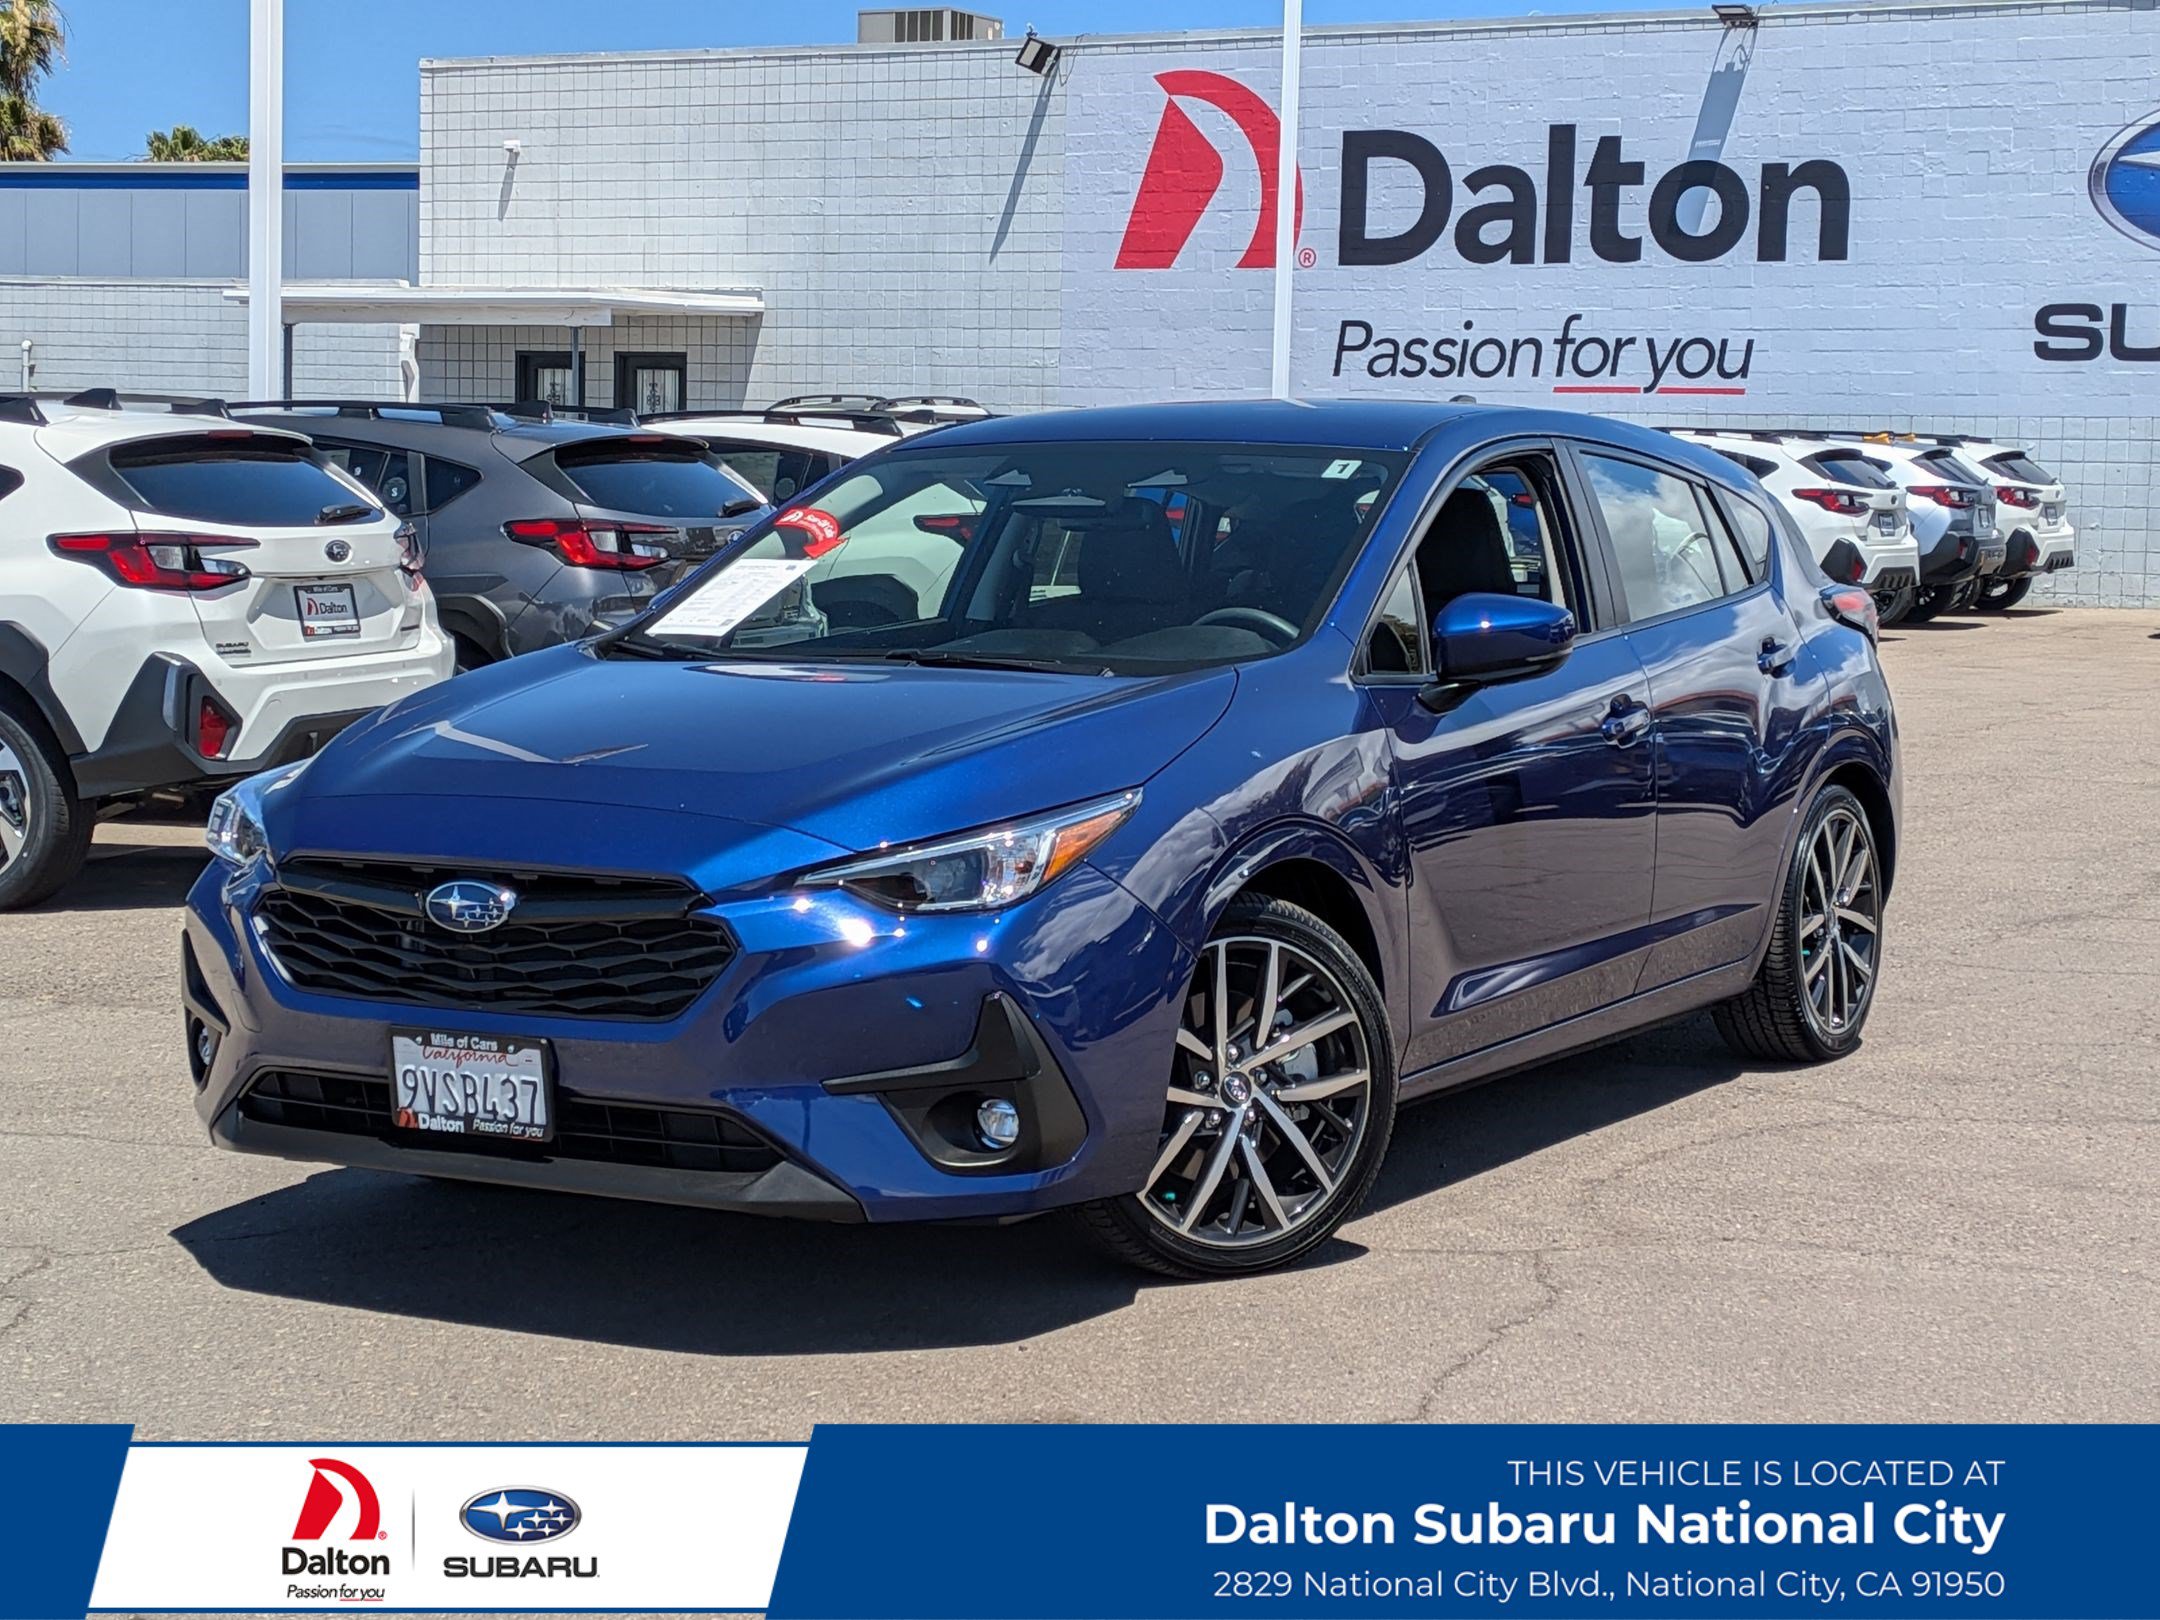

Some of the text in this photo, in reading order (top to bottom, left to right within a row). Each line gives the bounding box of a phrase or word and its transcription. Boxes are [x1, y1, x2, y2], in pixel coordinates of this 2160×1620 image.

[1338, 123, 1851, 266] Dalton
[1332, 313, 1755, 394] Passion for you
[319, 601, 349, 615] Dalton
[430, 1033, 499, 1052] Mile of Cars
[402, 1067, 538, 1125] 9VSB437
[418, 1113, 545, 1138] Dalton Passion for you
